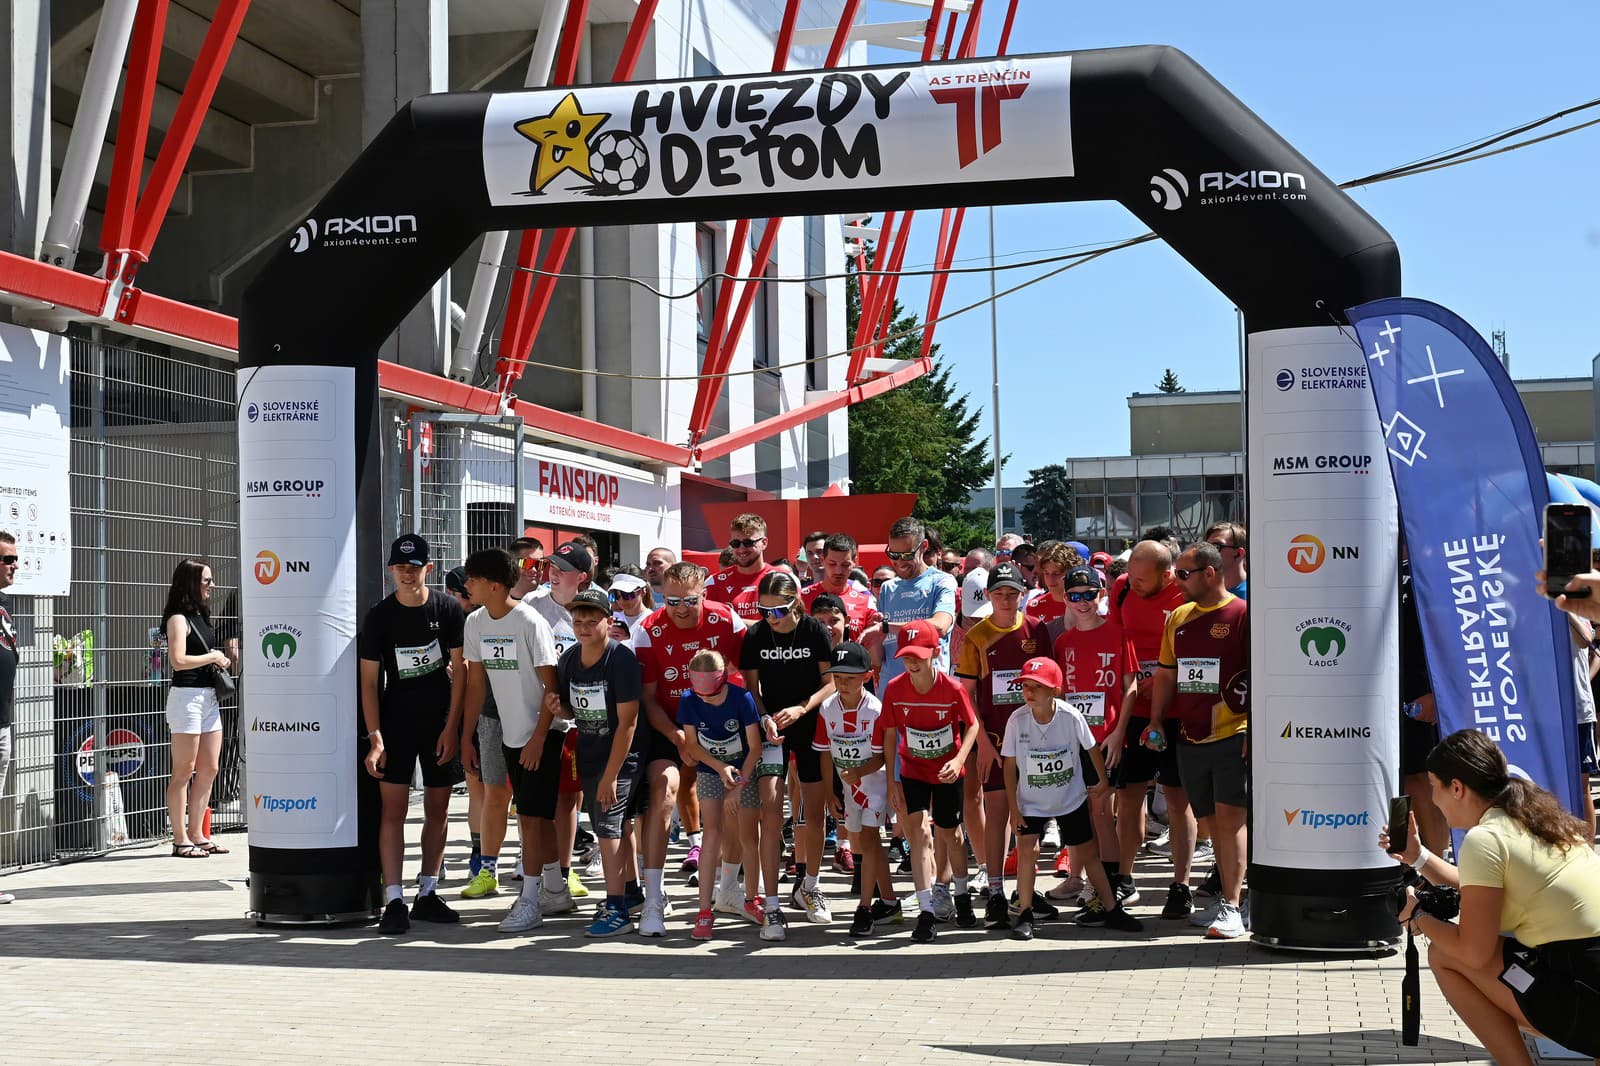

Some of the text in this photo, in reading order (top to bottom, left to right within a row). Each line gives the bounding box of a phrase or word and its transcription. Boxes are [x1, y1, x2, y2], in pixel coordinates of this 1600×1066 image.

[929, 69, 1032, 87] AS TRENČÍN
[631, 71, 911, 136] HVIEZDY
[660, 122, 881, 196] DEŤOM
[1200, 170, 1306, 192] AXION
[1201, 192, 1306, 205] axion4event.com
[324, 215, 417, 235] AXION
[323, 236, 417, 247] axion4event.com
[1301, 364, 1367, 377] SLOVENSKÉ
[1301, 377, 1367, 390] ELEKTRÁRNE
[263, 400, 319, 411] SLOVENSKÉ
[263, 411, 319, 422] ELEKTRÁRNE
[1273, 455, 1372, 470] MSM GROUP
[246, 480, 324, 493] MSM GROUP
[538, 460, 619, 509] FANSHOP
[1332, 547, 1359, 560] NN
[286, 560, 310, 573] NN
[258, 623, 303, 638] CEMENTÁREŇ
[1295, 616, 1352, 633] CEMENTÁREŇ
[493, 646, 504, 657] 21
[760, 647, 811, 661] adidas
[267, 660, 291, 669] LADCE
[412, 655, 430, 667] 36
[1308, 658, 1338, 667] LADCE
[1095, 669, 1116, 687] 20
[1188, 669, 1203, 680] 84
[575, 697, 588, 708] 10
[259, 721, 320, 732] KERAMING
[1295, 727, 1371, 739] KERAMING
[918, 739, 941, 749] 141
[710, 747, 727, 755] 65
[838, 748, 861, 759] 142
[1037, 760, 1063, 773] 140
[262, 794, 318, 813] Tipsport
[1300, 809, 1369, 830] Tipsport
